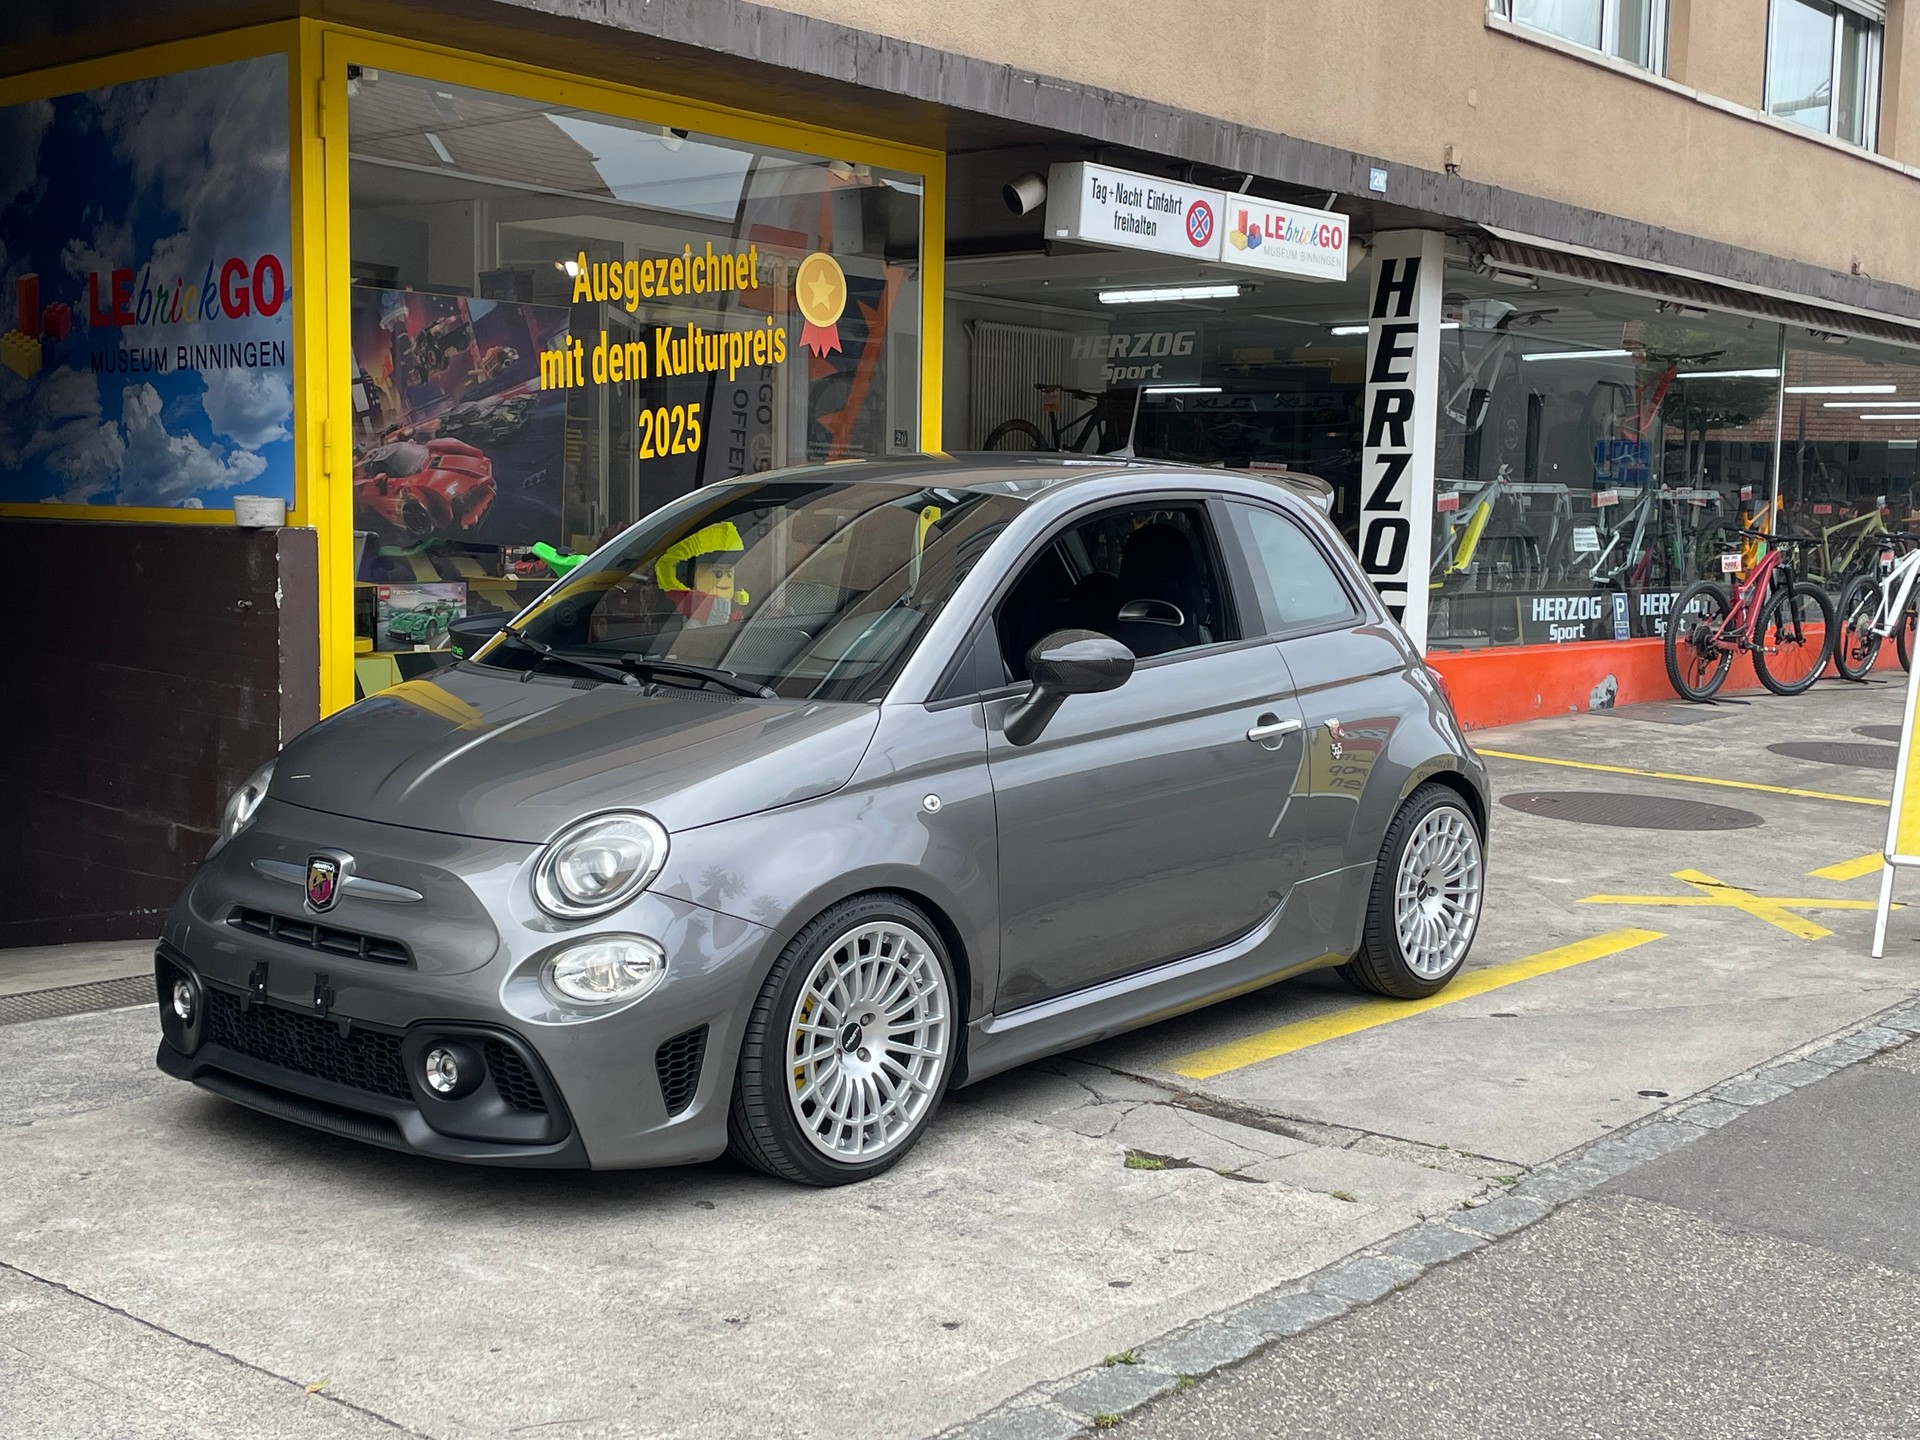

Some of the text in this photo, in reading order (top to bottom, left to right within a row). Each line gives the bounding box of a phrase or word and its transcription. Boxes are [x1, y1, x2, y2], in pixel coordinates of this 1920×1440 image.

[1373, 171, 1385, 187] 20
[1146, 188, 1183, 216] Einfahrt
[1114, 210, 1157, 237] freihalten
[1263, 245, 1342, 267] MUSEUM BINNINGEN
[571, 241, 759, 313] Ausgezeichnet
[91, 340, 286, 375] MUSEUM BINNINGEN
[540, 315, 787, 391] mit dem Kulturpreis
[1071, 331, 1196, 360] HERZOG
[1100, 362, 1163, 384] Sport
[638, 403, 701, 460] 2025
[1532, 596, 1602, 622] HERZOG
[1615, 597, 1625, 621] P
[1549, 623, 1586, 644] Sport
[1654, 617, 1686, 638] Spt
